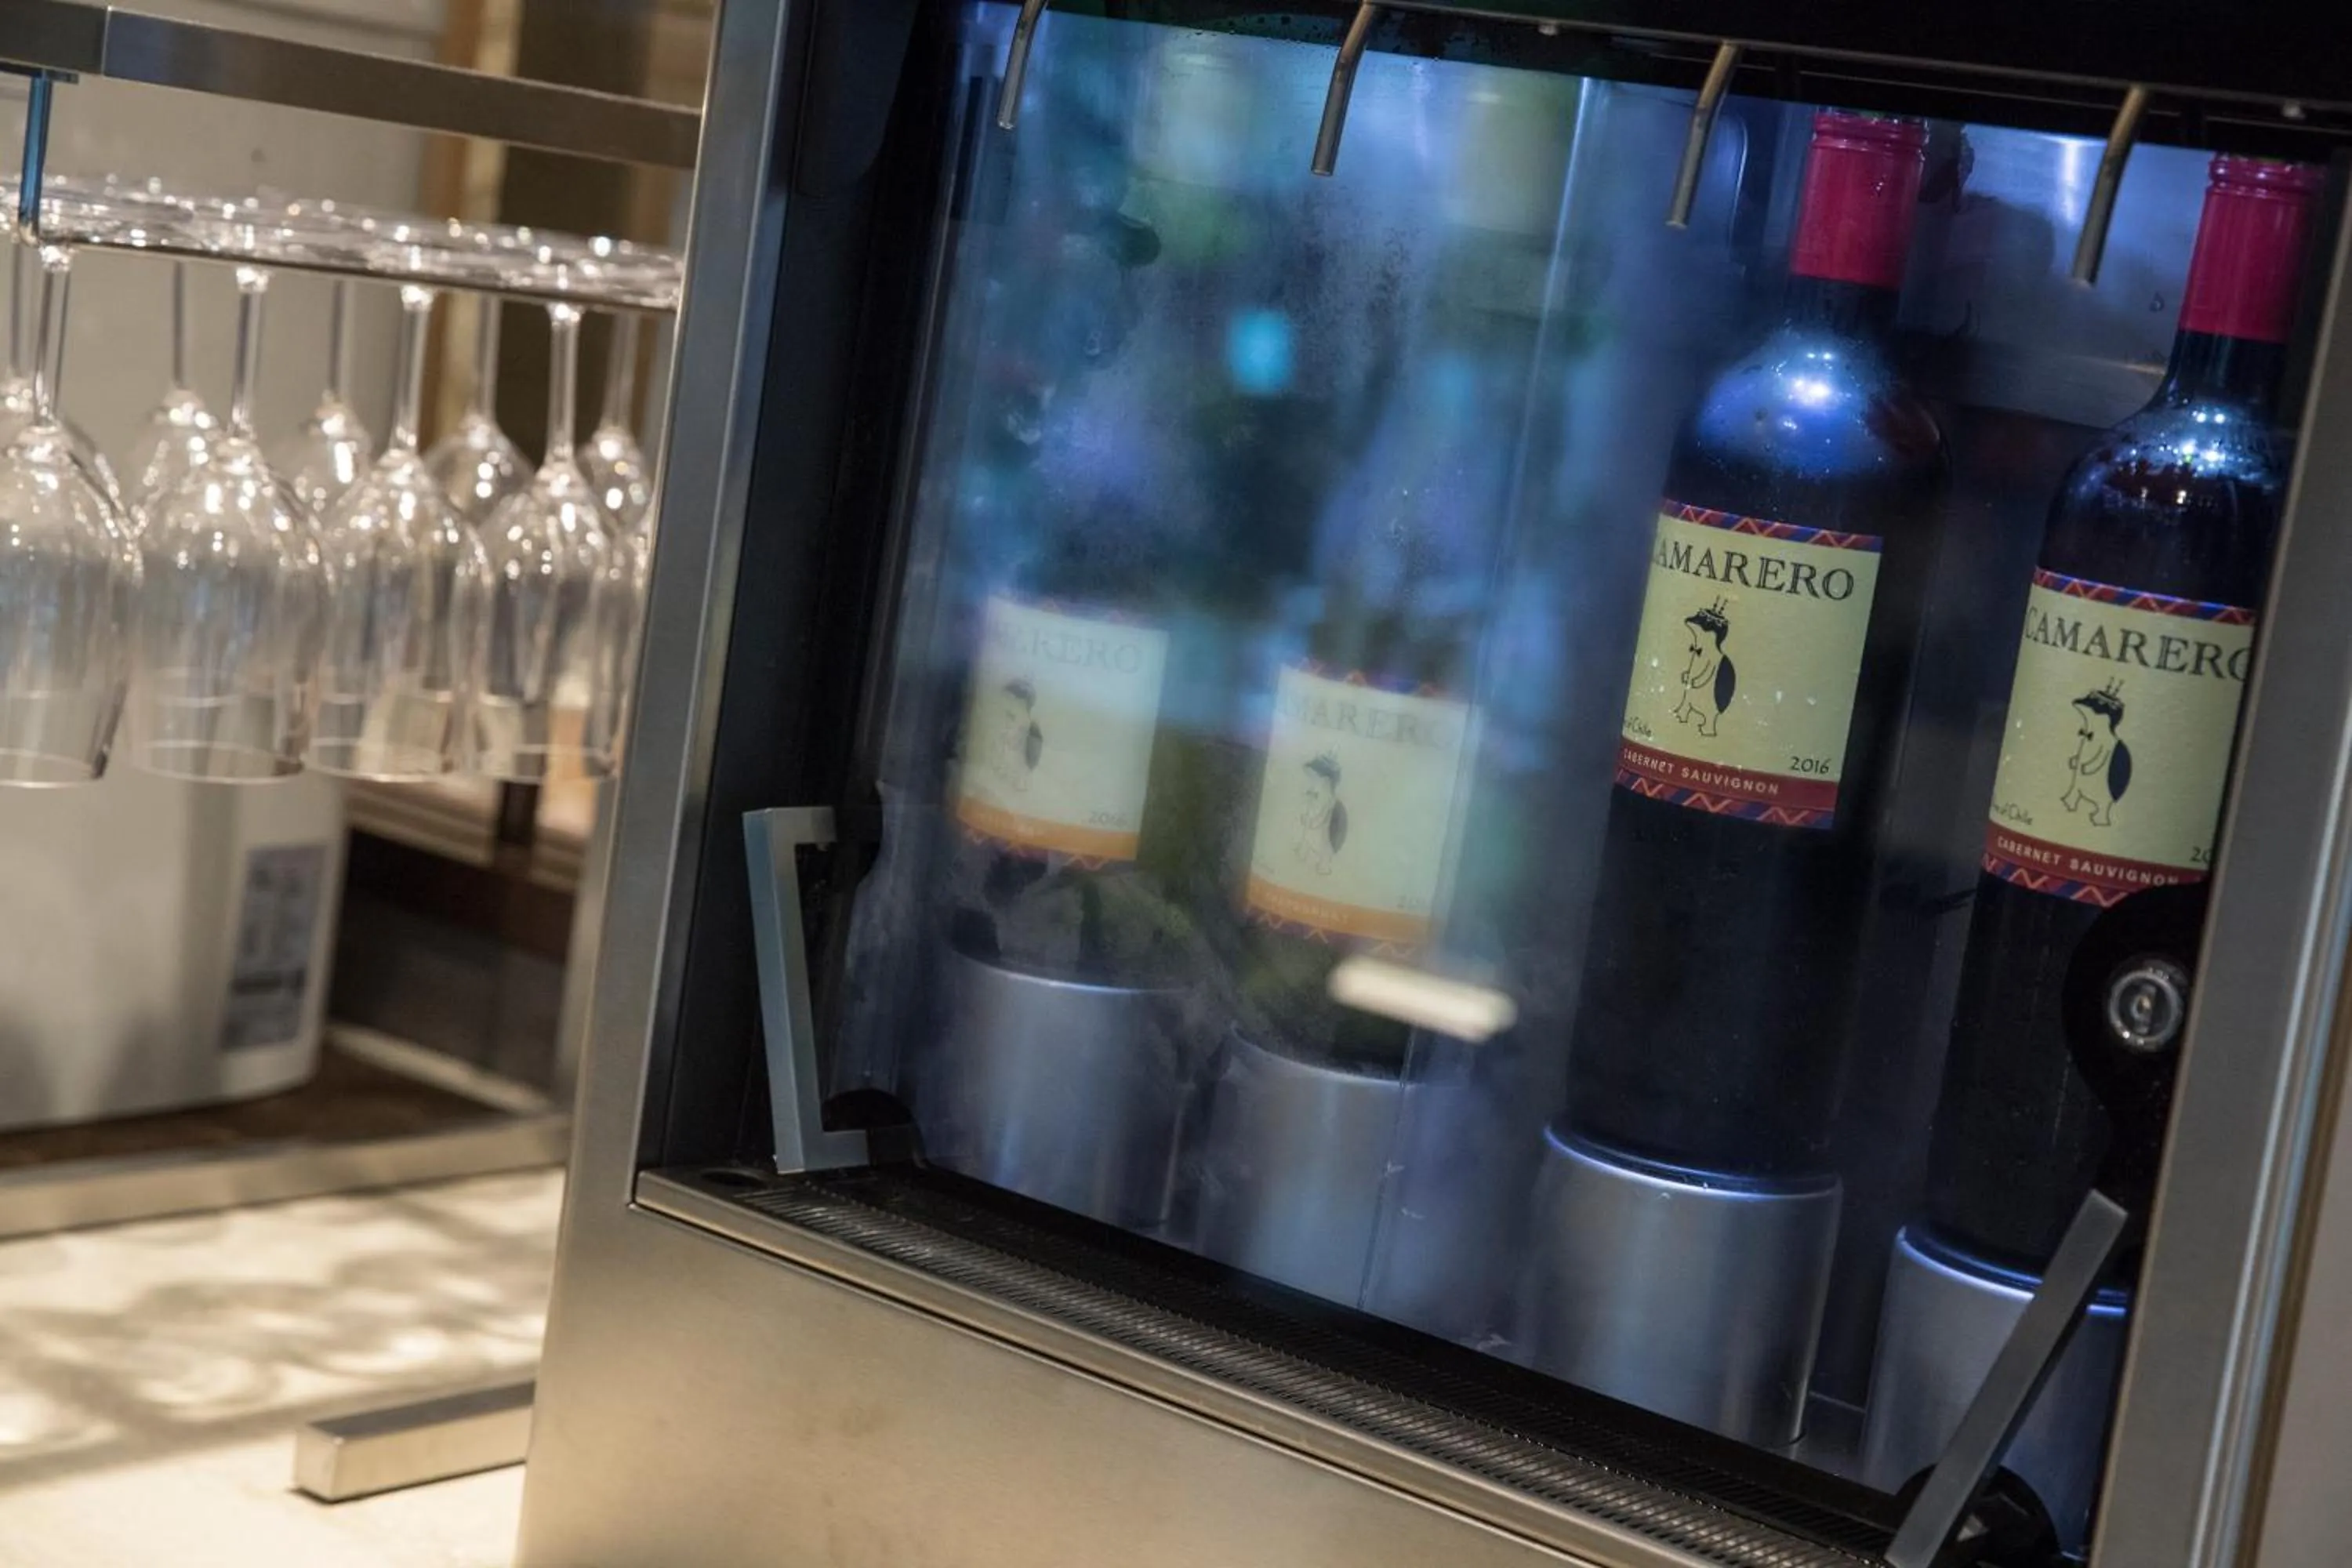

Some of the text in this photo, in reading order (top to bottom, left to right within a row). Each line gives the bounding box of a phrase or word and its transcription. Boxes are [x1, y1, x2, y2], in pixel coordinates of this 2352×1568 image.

[1652, 536, 1854, 601] AMARERO
[2024, 606, 2249, 682] CAMARERO
[1790, 755, 1832, 775] 2016
[1681, 768, 1780, 796] SAUVIGNON
[1998, 835, 2063, 867] CABERNET
